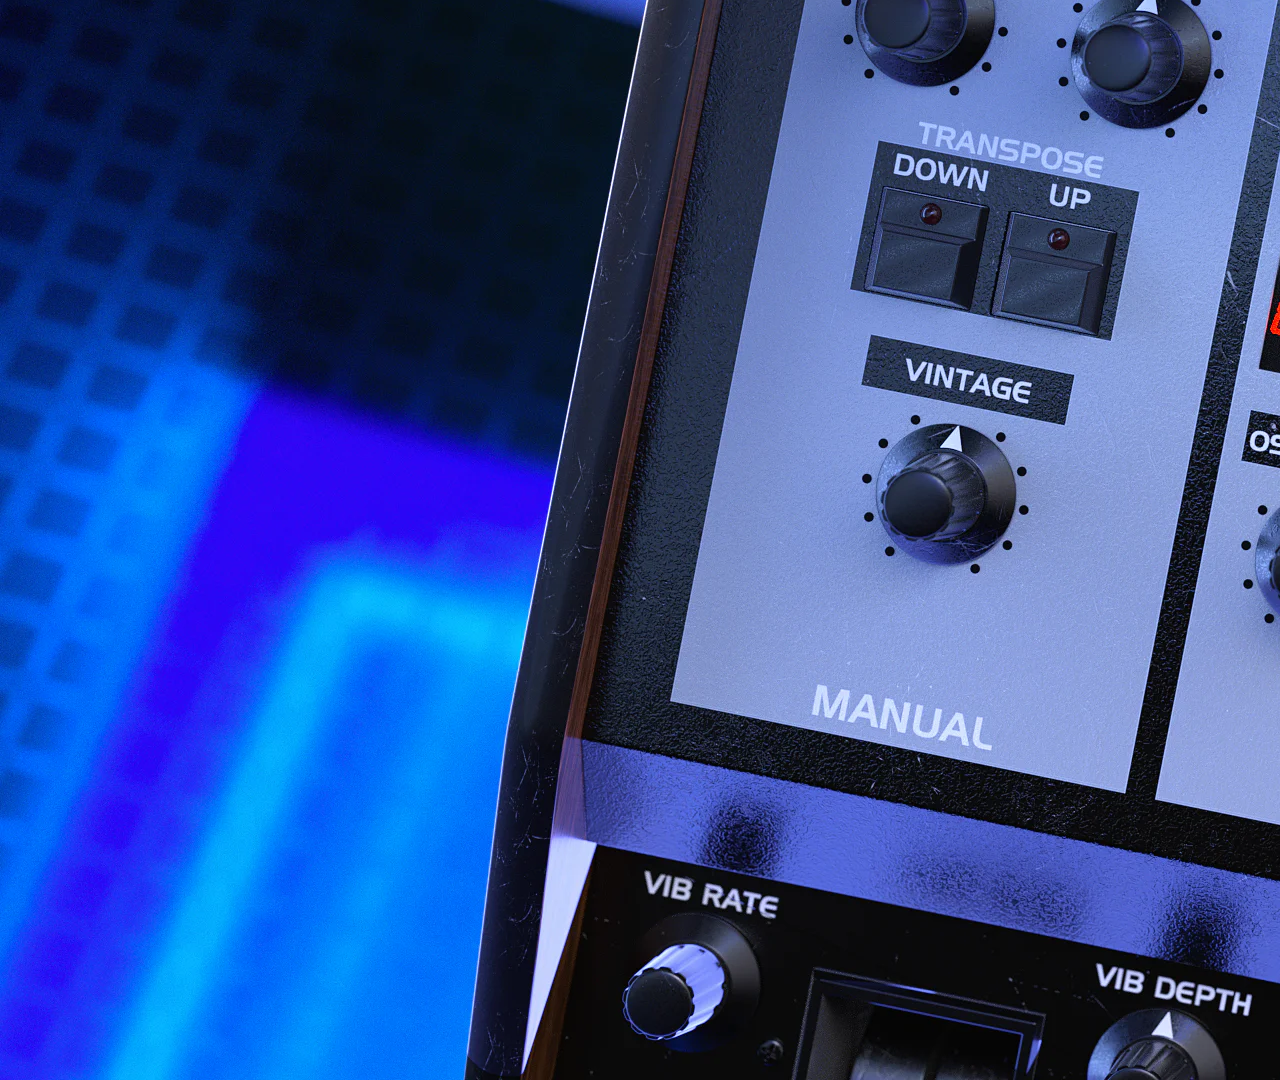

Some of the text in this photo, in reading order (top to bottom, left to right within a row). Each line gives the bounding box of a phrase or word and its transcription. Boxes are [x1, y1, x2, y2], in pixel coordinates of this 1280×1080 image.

[893, 152, 990, 192] DOWN
[917, 121, 1105, 180] TRANSPOSE
[1049, 183, 1092, 210] UP
[905, 357, 1033, 405] VINTAGE
[811, 684, 993, 751] MANUAL
[644, 870, 779, 919] VIB RATE
[1096, 963, 1253, 1017] VIB DEPTH
